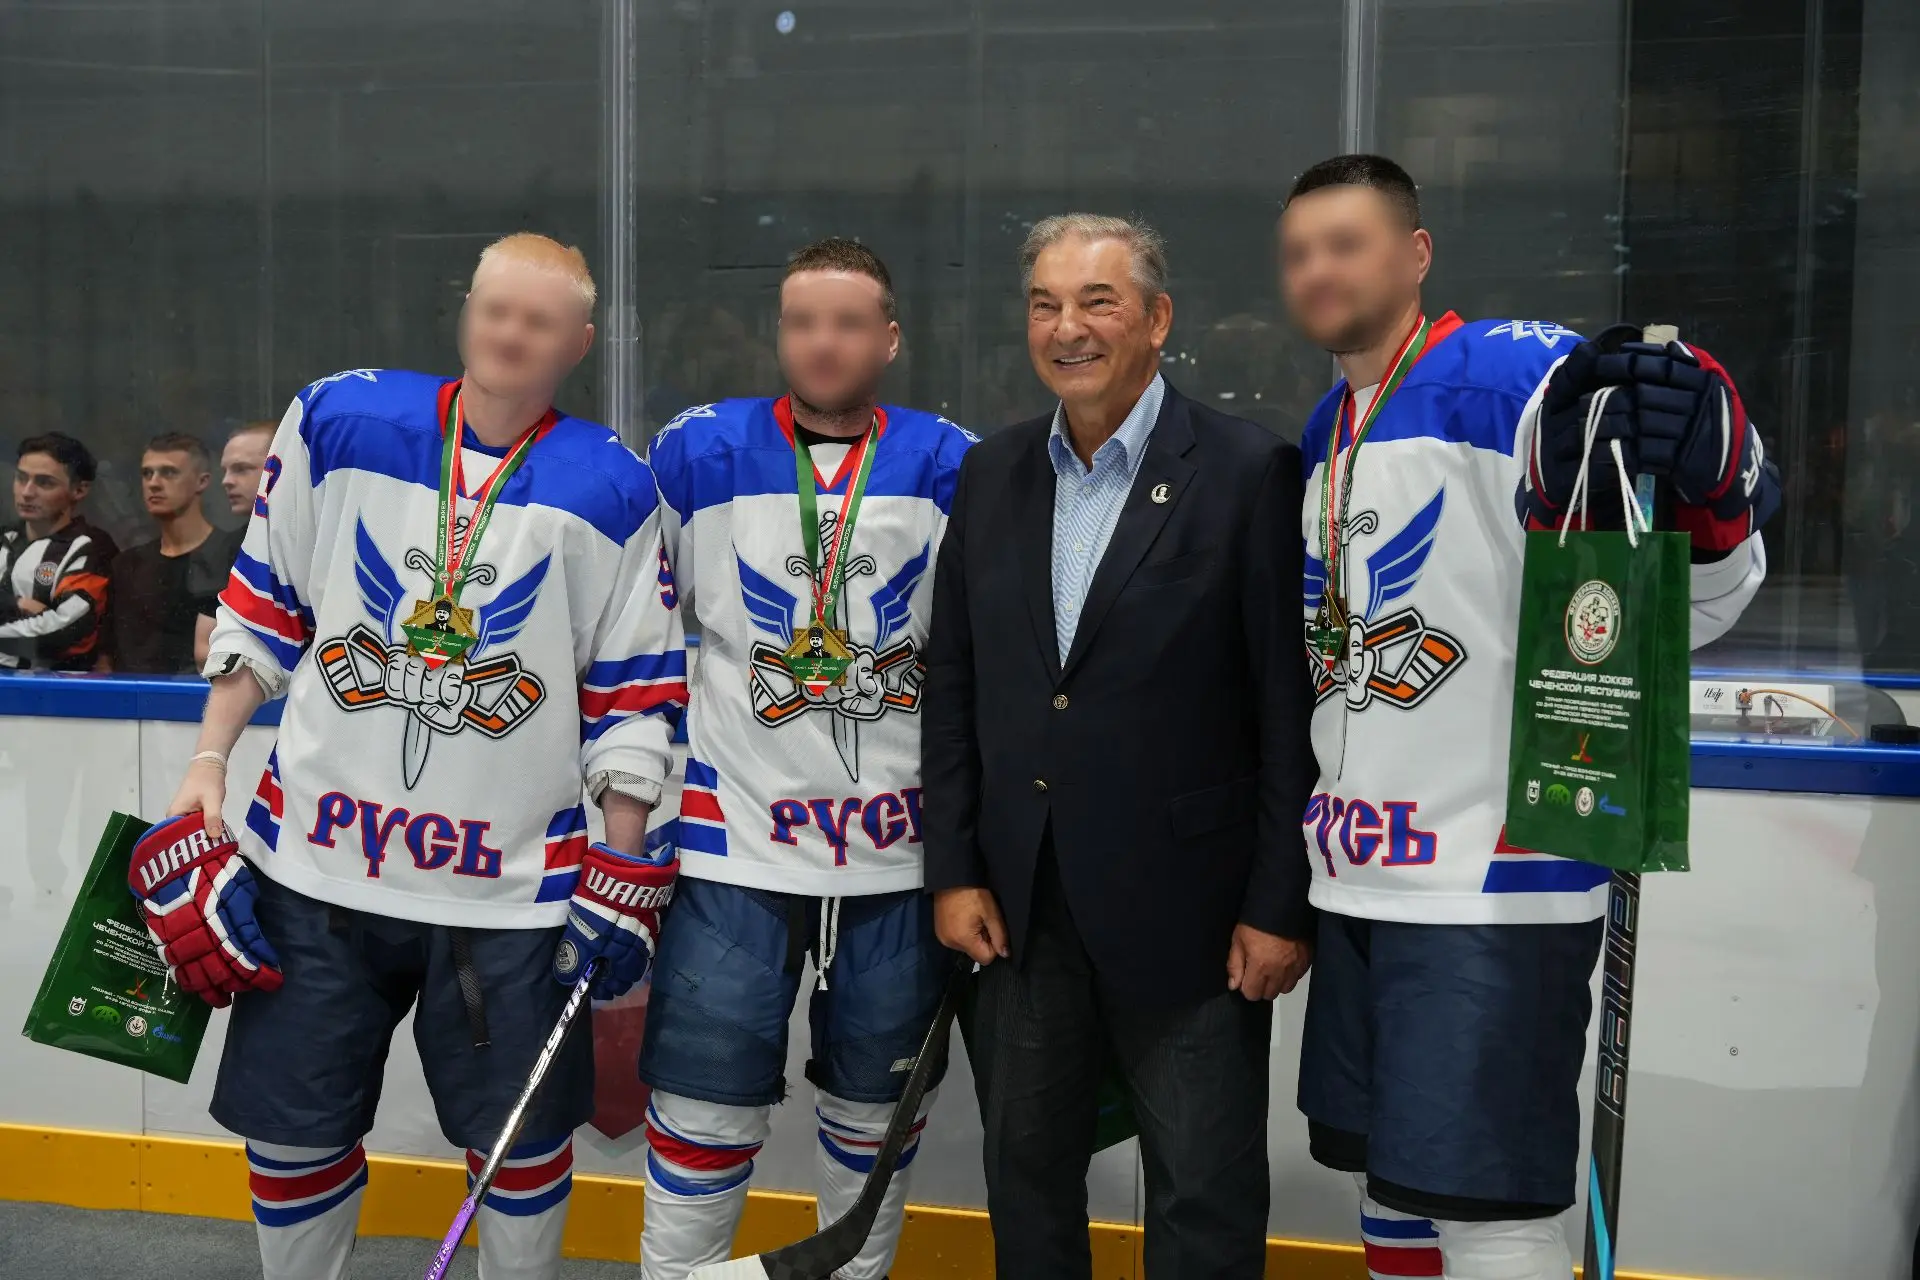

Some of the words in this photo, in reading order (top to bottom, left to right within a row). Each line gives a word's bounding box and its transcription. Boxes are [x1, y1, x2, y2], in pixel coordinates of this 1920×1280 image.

[1541, 669, 1597, 683] ФЕДЕРАЦИЯ
[1598, 674, 1634, 686] ХОККЕЯ
[1529, 679, 1582, 693] ЧЕЧЕНСКОЙ
[1583, 685, 1641, 700] РЕСПУБЛИКИ
[307, 791, 502, 878] РУСЬ
[93, 921, 145, 948] ЧЕЧЕНСКОЙ
[107, 918, 152, 940] ФЕДЕРАЦ
